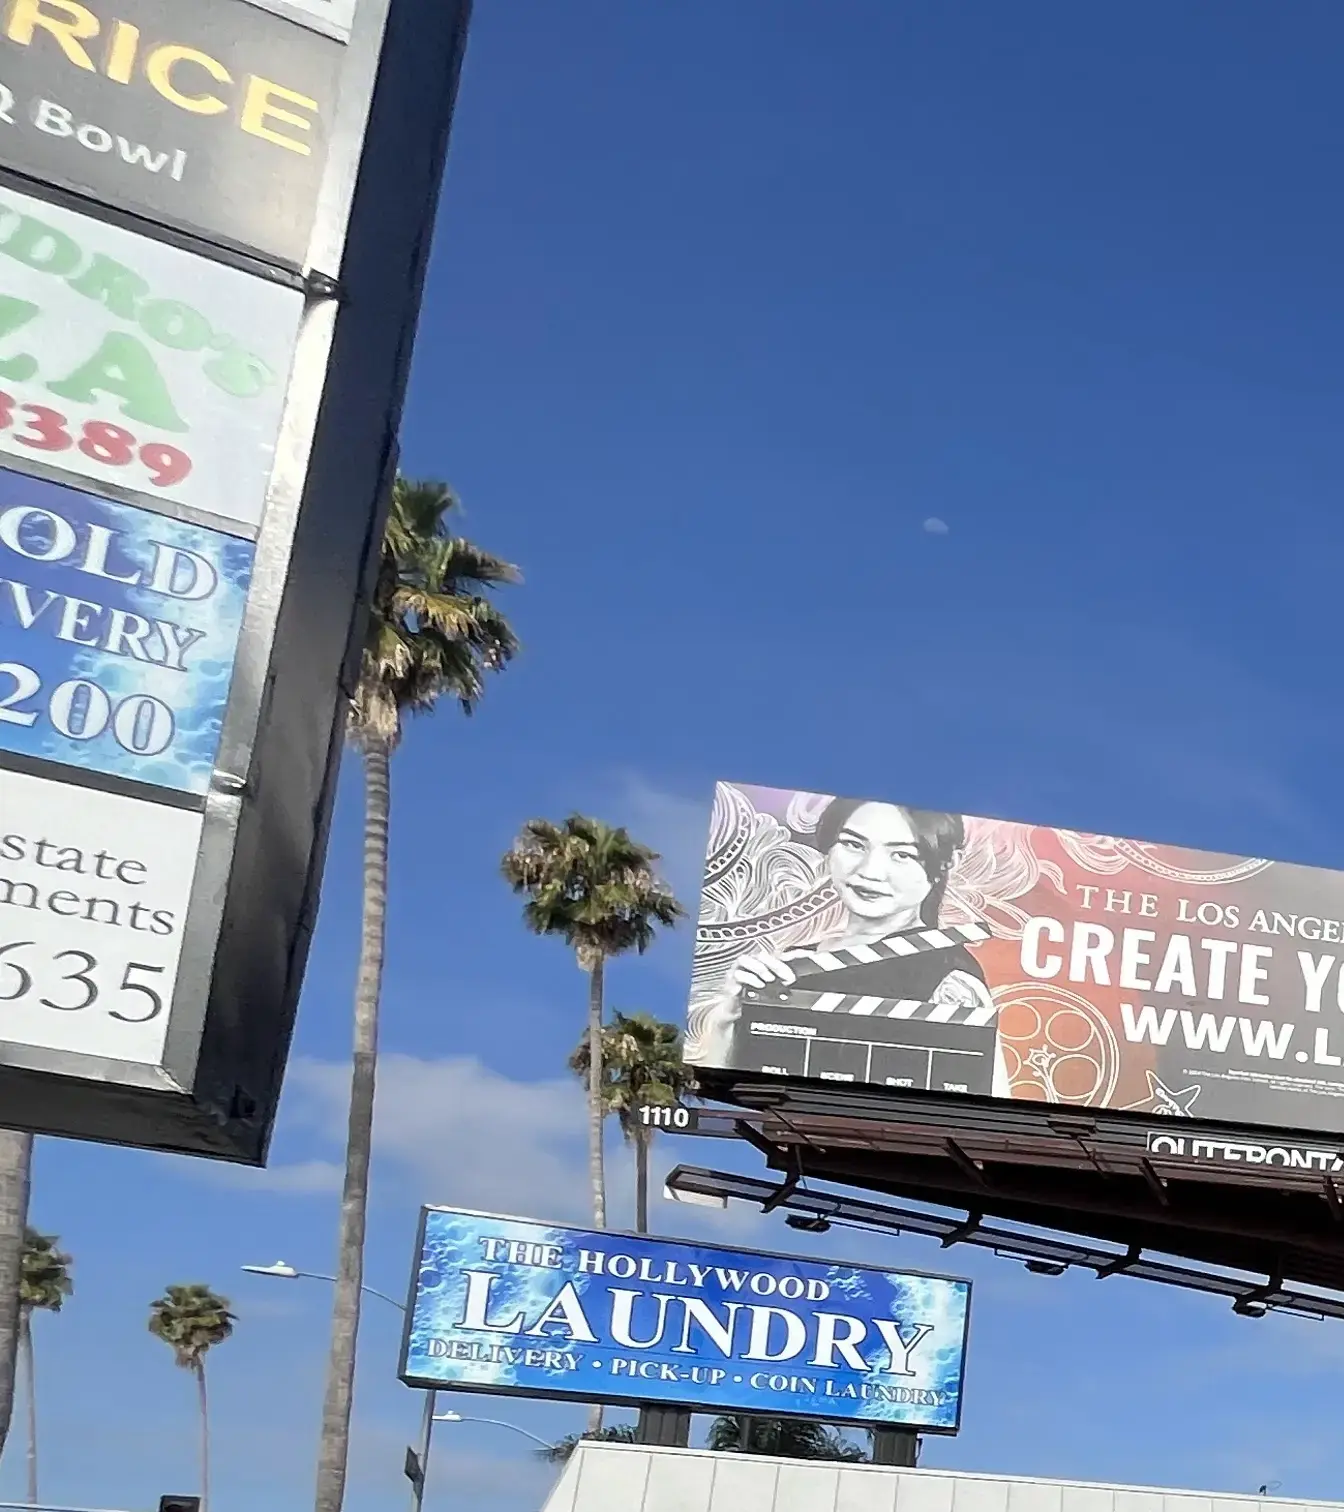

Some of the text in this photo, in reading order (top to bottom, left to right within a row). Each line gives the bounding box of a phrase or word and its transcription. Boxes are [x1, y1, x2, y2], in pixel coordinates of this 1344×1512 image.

[7, 0, 319, 156] RICE
[35, 99, 188, 181] Bowl
[0, 506, 218, 600] OLD
[0, 578, 206, 671] VERY
[0, 661, 175, 756] 200
[0, 834, 148, 885] state
[1076, 884, 1158, 918] THE
[1176, 898, 1240, 929] LOS
[1020, 916, 1273, 1006] CREATE
[638, 1105, 690, 1128] 1110
[479, 1236, 830, 1302] THE HOLLYWOOD
[454, 1268, 936, 1378] LAUNDRY
[427, 1338, 947, 1407] DELIVERY PICK-UP COIN LAUNDRY
